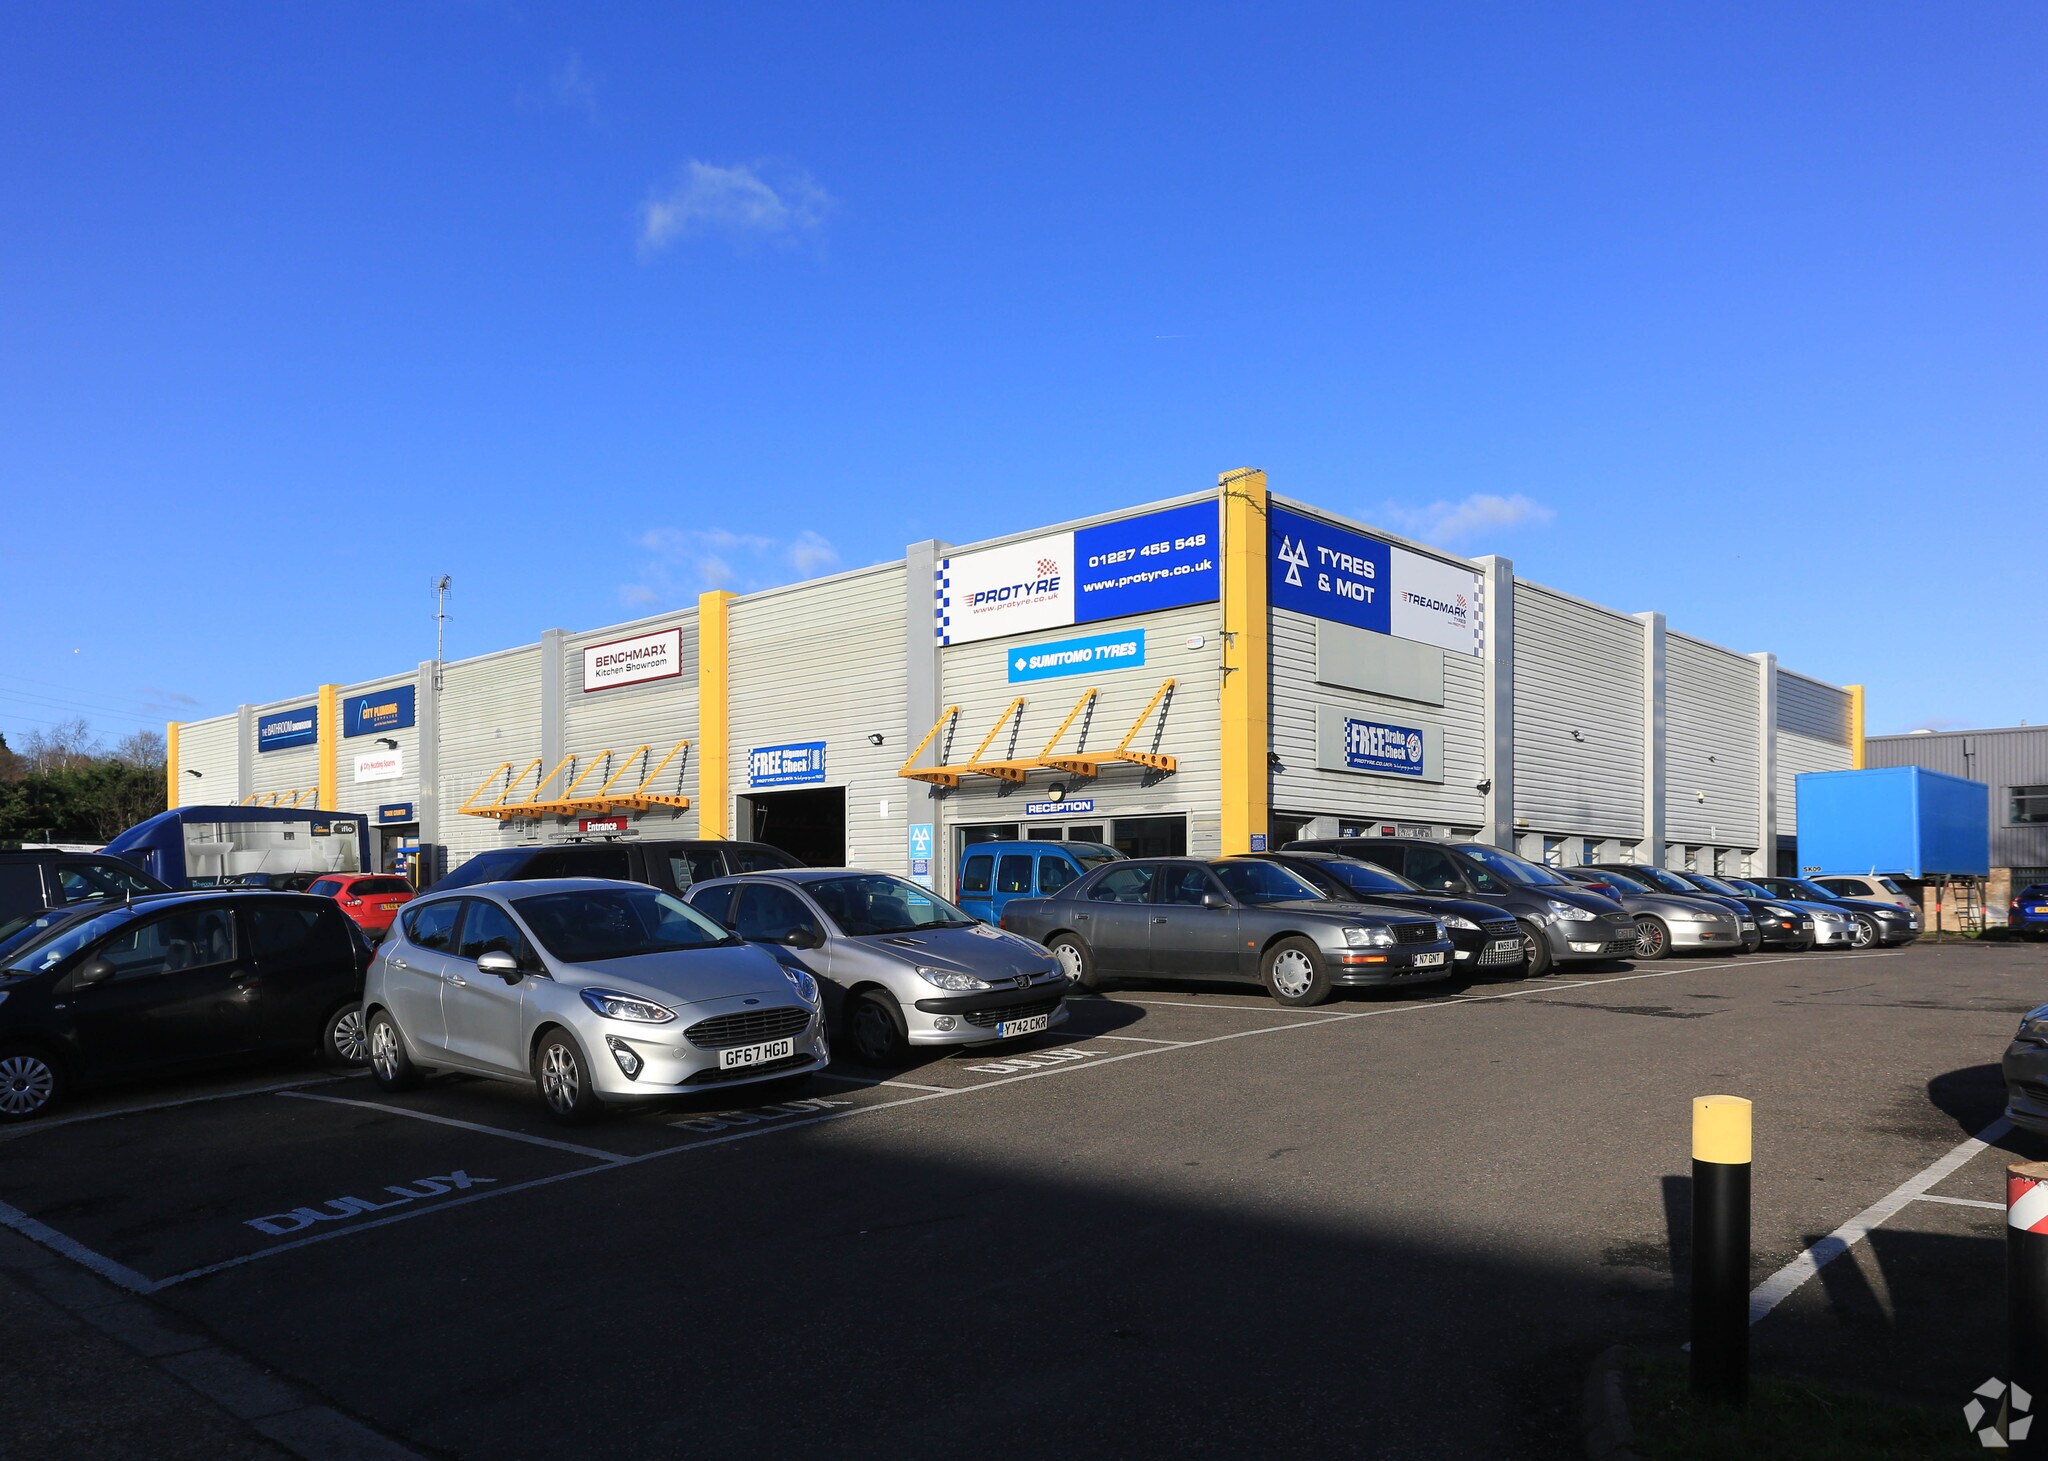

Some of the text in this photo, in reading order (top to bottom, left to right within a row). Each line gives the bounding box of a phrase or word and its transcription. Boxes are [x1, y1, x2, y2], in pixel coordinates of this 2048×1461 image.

[1088, 534, 1206, 568] 01227 455 548
[1317, 546, 1375, 579] TYRES
[1083, 559, 1212, 592] www.protyre.co.uk
[974, 577, 1061, 606] PROTYRE
[1318, 573, 1375, 604] & MOT
[973, 592, 1059, 614] www.protyre.co.uk
[1408, 592, 1467, 619] TREADMARK
[595, 643, 667, 668] BENCHMARX
[595, 657, 667, 678] Kitchen Showroom
[1029, 641, 1136, 669] SUMITOMO TYRES
[362, 702, 398, 719] CITY PLUMBING
[267, 720, 293, 736] BATHROOM
[1351, 723, 1405, 757] FREE Brake
[753, 750, 782, 776] FREE
[1385, 744, 1406, 760] Check
[782, 758, 808, 773] Check
[1028, 801, 1091, 814] RECEPTION
[587, 821, 617, 831] Entrance
[1420, 953, 1440, 964] N7 GNT
[1005, 1016, 1046, 1035] Y742 CKR
[726, 1041, 788, 1065] GF67 HGD
[962, 1048, 1108, 1074] DULUX
[242, 1169, 498, 1235] DULUX
